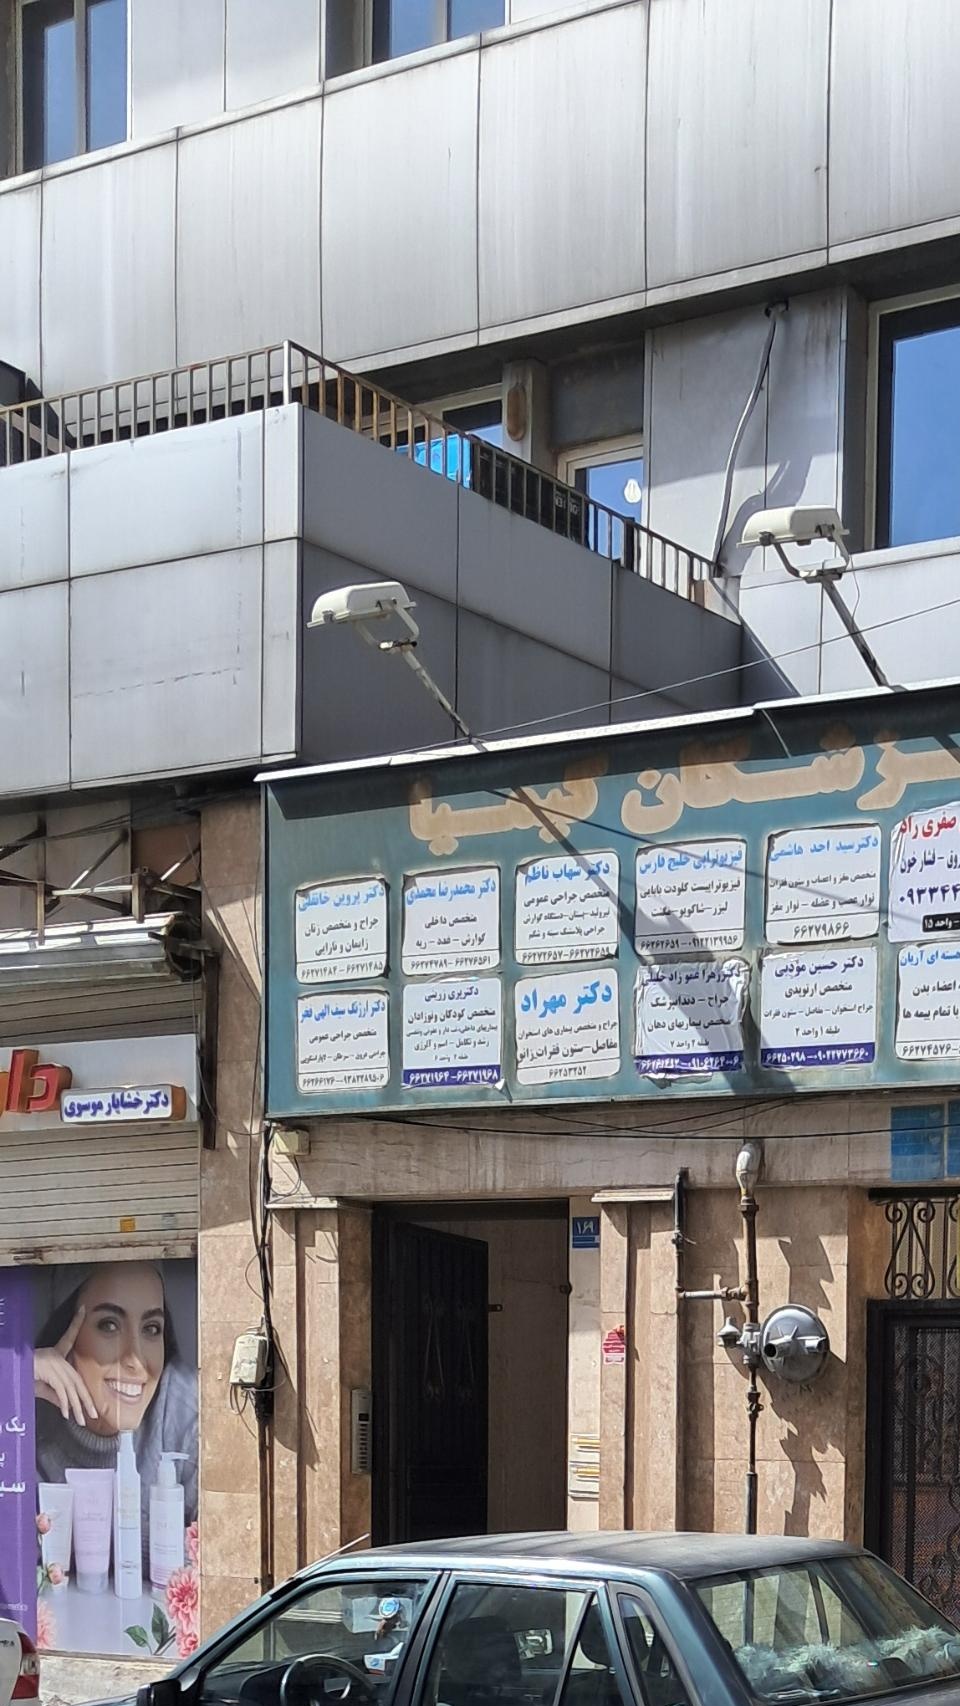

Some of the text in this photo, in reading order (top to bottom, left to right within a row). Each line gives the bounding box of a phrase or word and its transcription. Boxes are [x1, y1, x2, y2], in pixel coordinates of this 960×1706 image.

[410, 752, 609, 858] کیمیا
[900, 816, 918, 839] راد
[922, 812, 956, 837] صفری
[769, 841, 854, 861] سید احد هاشمی
[640, 853, 690, 874] خلیج فارس
[900, 852, 917, 873] خون
[919, 849, 935, 872] فشار
[525, 861, 609, 887] دکتر شهاب ناظم
[479, 878, 496, 898] دکتر
[769, 875, 849, 890] مغز اعصاب فقرات
[364, 884, 384, 903] دکتر
[407, 886, 436, 905] محمدی
[524, 888, 610, 907] متخصص جراحی عمومی
[770, 893, 875, 915] نوار عضله نوار مغز
[305, 917, 378, 936] جراح متخصص زنان
[425, 914, 477, 929] متخصص داخلی
[935, 918, 952, 928] واحد
[584, 926, 605, 936] جراحی
[793, 922, 849, 938] ۶۶۲۷۹۸۶۶
[345, 938, 368, 951] زایمان
[437, 932, 485, 946] گوارش غدد
[900, 950, 923, 966] آریان
[927, 951, 938, 964] ای
[941, 950, 960, 960] هسته
[809, 956, 863, 975] دکتر حسین
[785, 981, 852, 998] متخصص ارتوپدی
[912, 984, 929, 996] بدن
[932, 980, 956, 991] اعضاء
[521, 981, 612, 1018] دکتر مهراد
[650, 994, 729, 1010] جراح دندانپزشک
[314, 1004, 330, 1021] الهی
[331, 1005, 345, 1018] سیف
[371, 999, 385, 1017] دکتر
[440, 1008, 495, 1021] متخصص کودکان
[764, 1003, 873, 1019] جراح استخوان مفاصل فقرات
[914, 1009, 930, 1020] بیمه
[933, 1005, 950, 1020] تمام
[542, 1027, 553, 1037] های
[554, 1026, 572, 1035] بیماری
[574, 1023, 596, 1033] متخصص
[603, 1020, 617, 1029] جراح
[648, 1017, 730, 1032] متخصص بیماریهای دهان
[309, 1027, 376, 1043] متخصص جراحی عمومی
[802, 1028, 818, 1038] واحد
[65, 1091, 169, 1117] دکتر خشایار موسوی
[5, 1416, 26, 1437] یک
